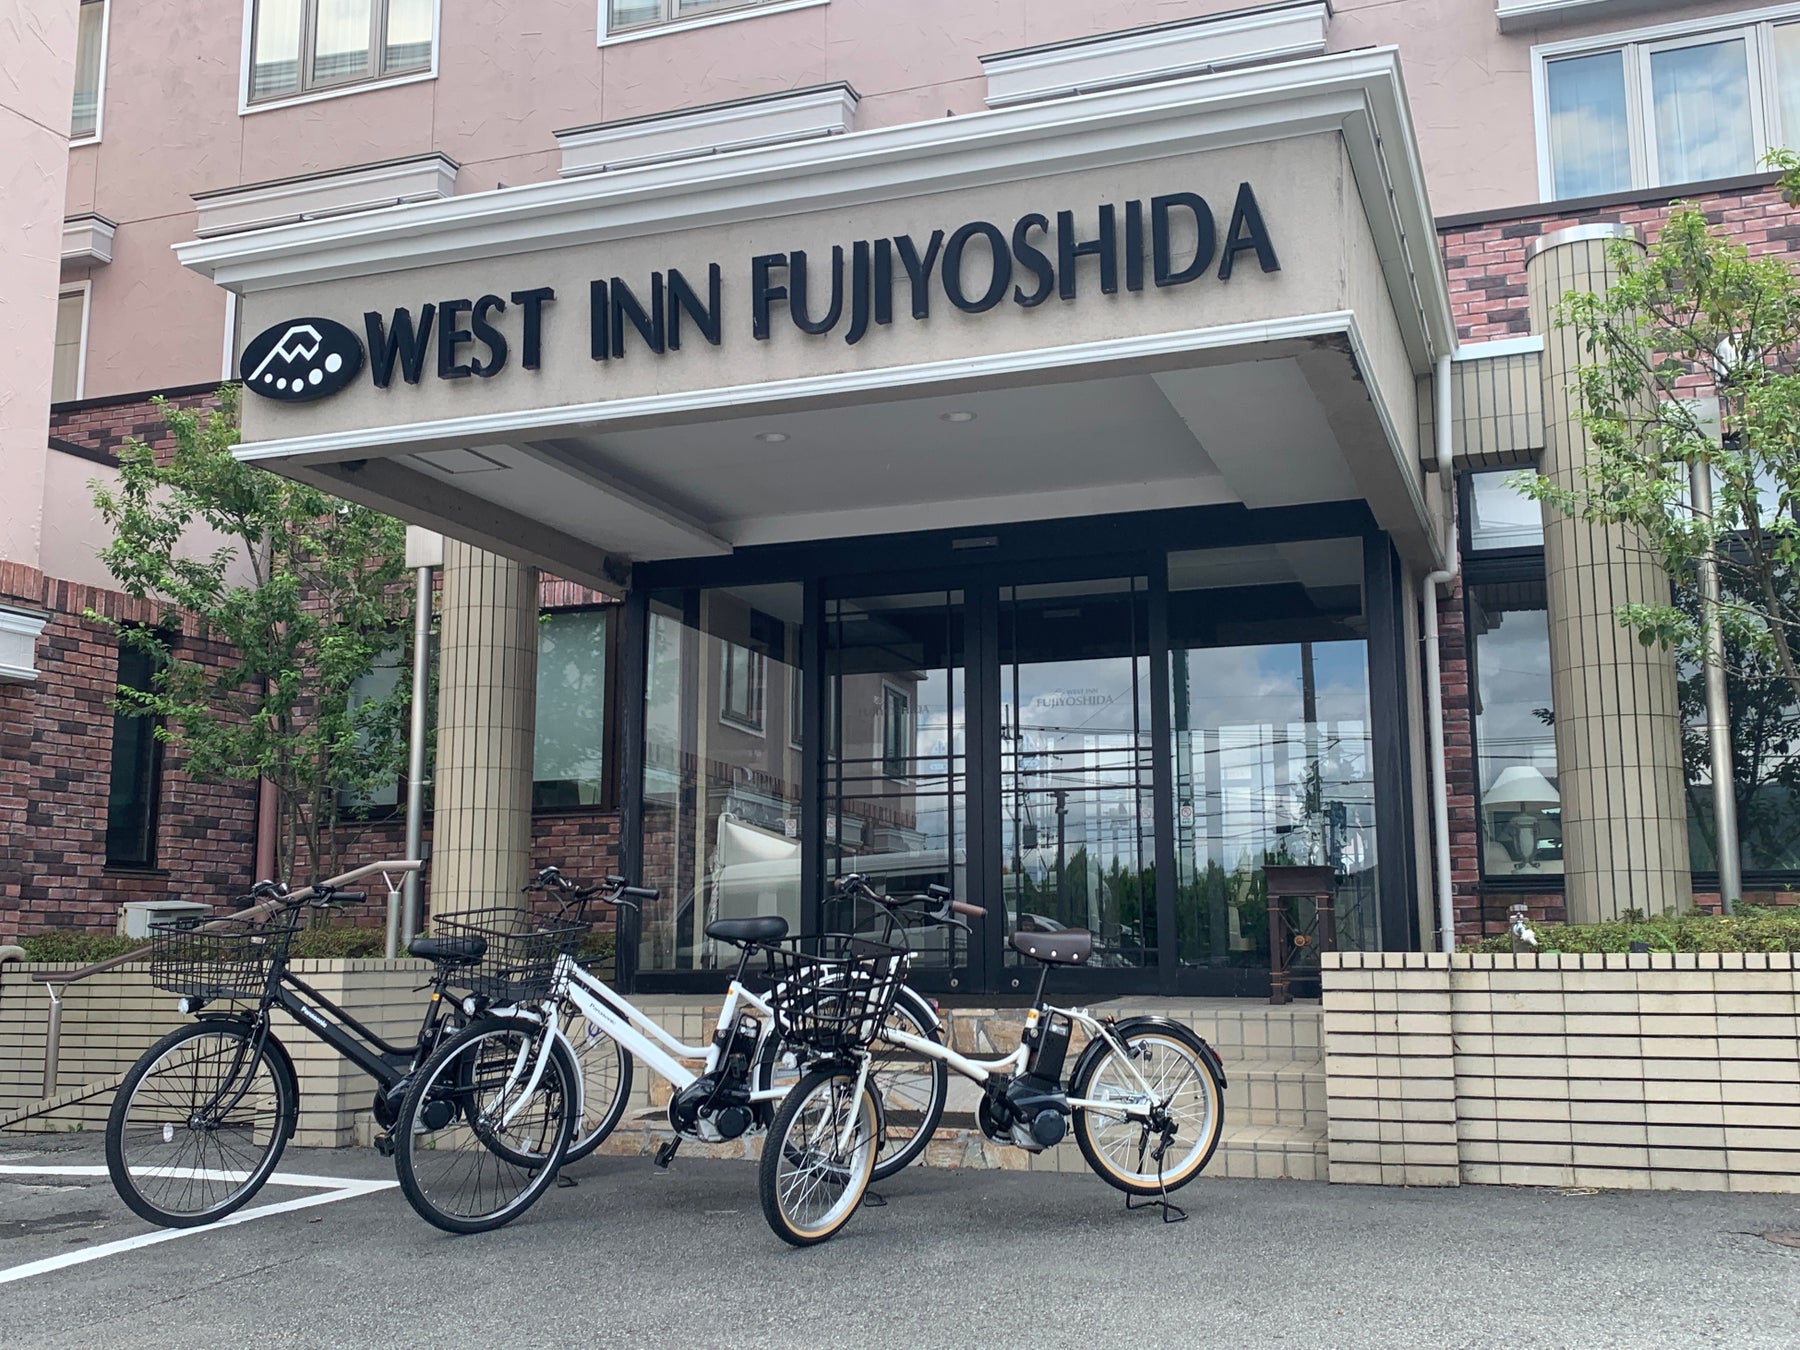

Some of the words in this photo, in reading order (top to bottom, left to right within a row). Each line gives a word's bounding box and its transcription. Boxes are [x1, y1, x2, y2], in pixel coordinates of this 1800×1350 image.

[363, 286, 556, 389] WEST
[591, 262, 721, 361] INN
[752, 181, 1281, 345] FUJIYOSHIDA
[1036, 695, 1113, 708] FUJIYOSHIDA
[300, 1005, 328, 1028] Panasonic
